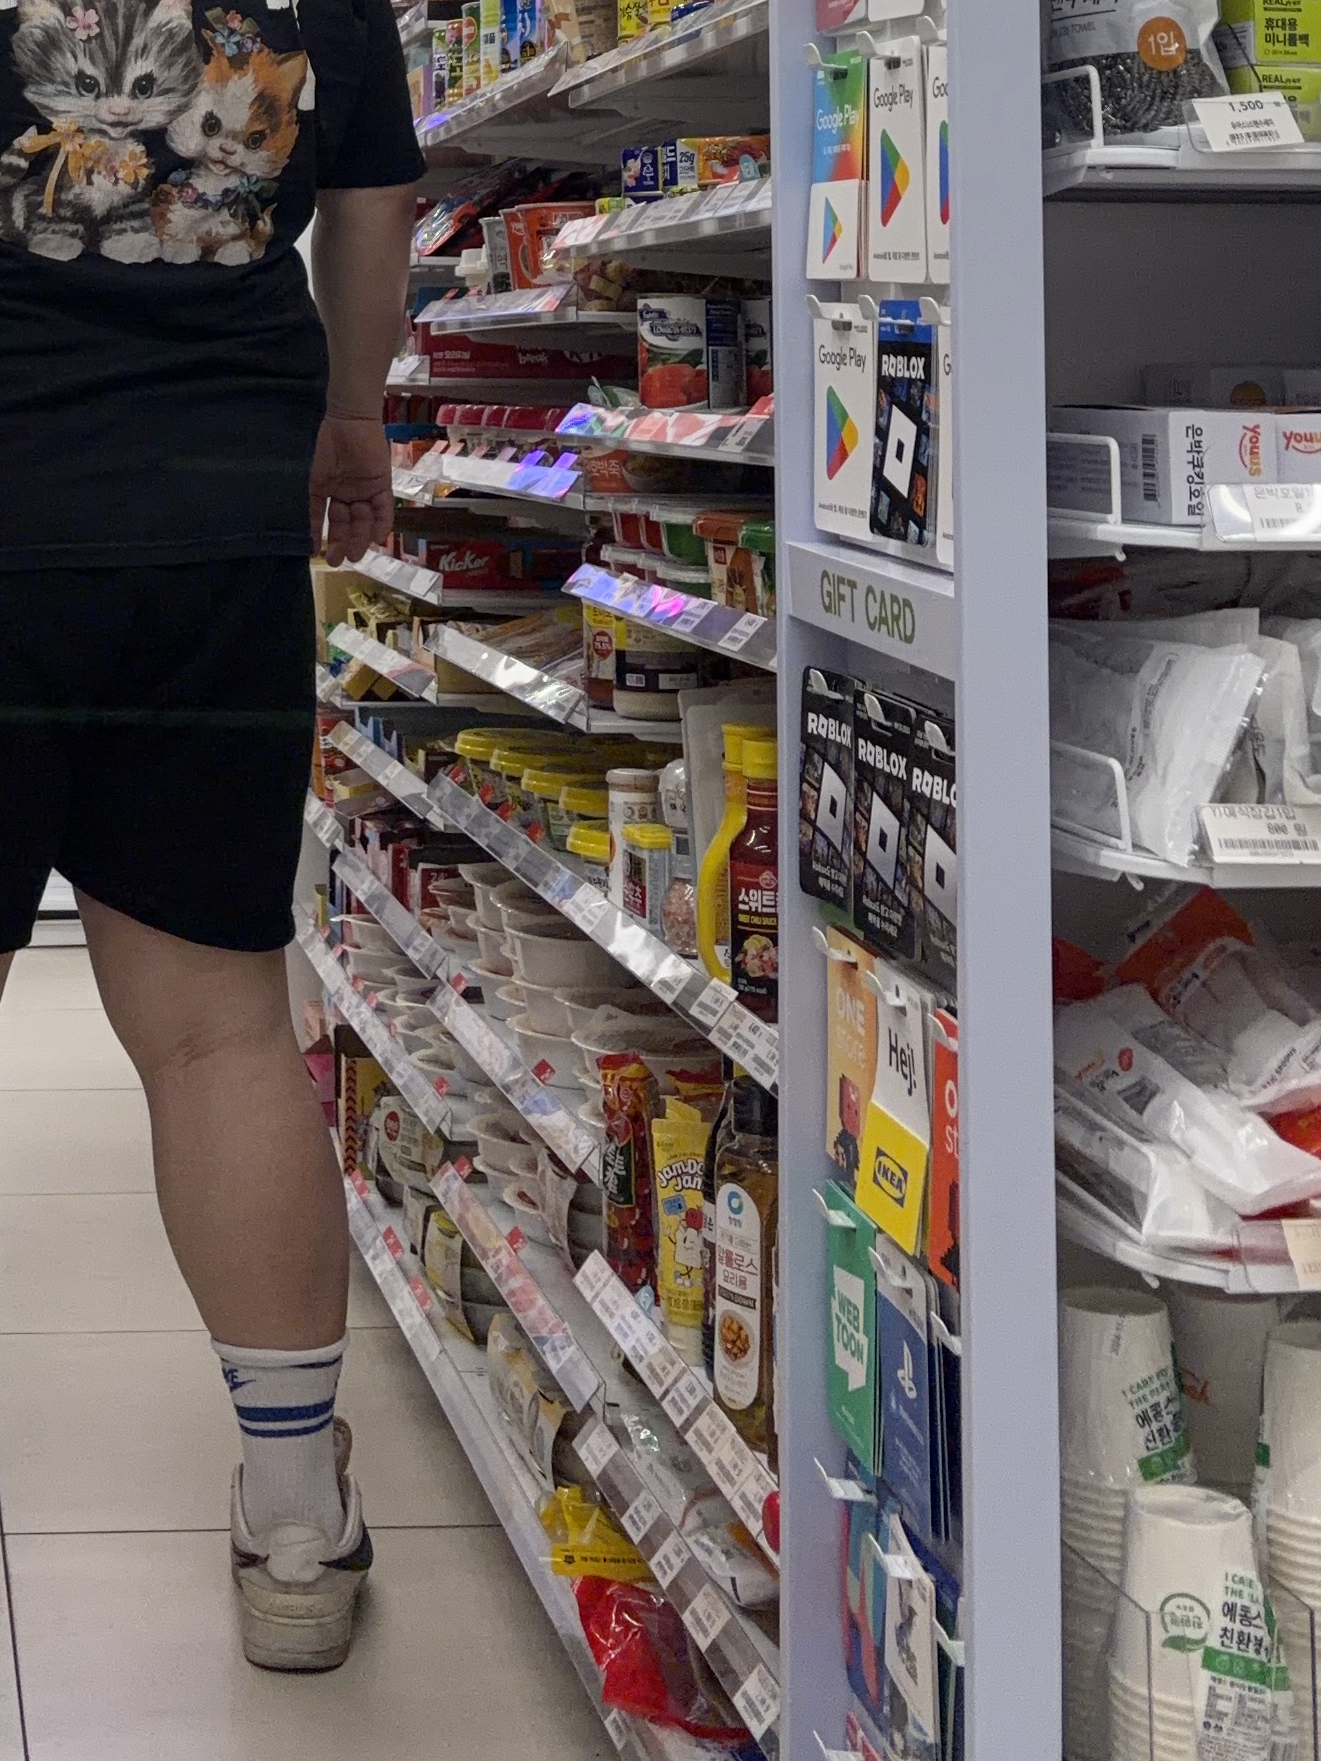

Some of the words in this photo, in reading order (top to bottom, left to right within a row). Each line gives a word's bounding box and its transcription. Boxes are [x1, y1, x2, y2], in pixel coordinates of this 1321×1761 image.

[1264, 17, 1298, 32] 휴대용
[1148, 31, 1180, 56] 1입
[873, 86, 899, 112] Google
[898, 84, 914, 108] Play
[1228, 99, 1264, 114] 1,500
[816, 105, 844, 135] Google
[844, 103, 860, 127] Play
[818, 344, 848, 372] Google
[848, 347, 867, 374] Play
[881, 353, 926, 380] ROBLOX
[1282, 430, 1321, 452] youu
[820, 569, 858, 621] GIFT
[864, 571, 916, 646] CARD
[807, 712, 852, 749] ROBLOX
[857, 737, 908, 782] ROBLOX
[912, 766, 957, 809] ROBL
[738, 887, 780, 914] 스위트
[836, 987, 866, 1038] ONE
[888, 1027, 918, 1097] Hej!
[878, 1159, 906, 1190] IKEA
[837, 1290, 861, 1336] WEB
[835, 1311, 865, 1366] TOON
